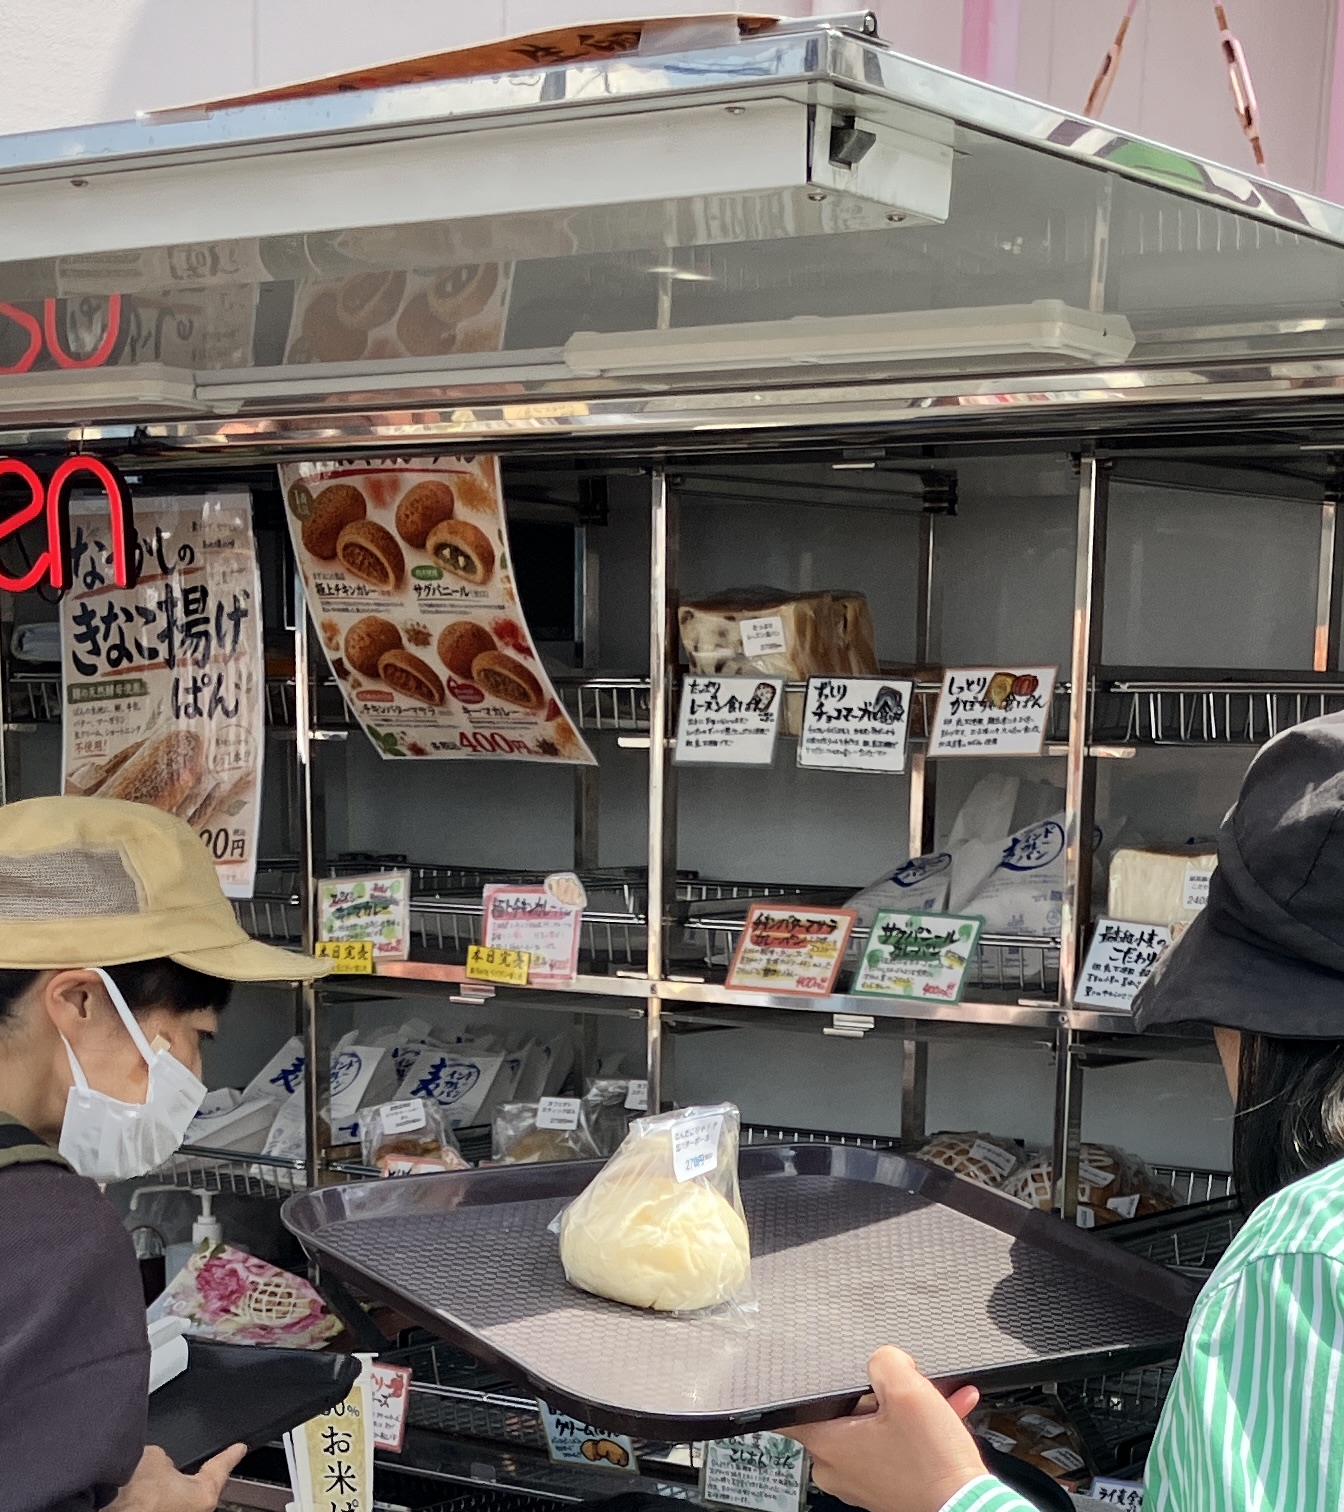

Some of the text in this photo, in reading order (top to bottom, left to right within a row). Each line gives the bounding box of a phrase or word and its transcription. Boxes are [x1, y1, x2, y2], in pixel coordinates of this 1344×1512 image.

[412, 582, 470, 598] サグパニール
[71, 584, 252, 678] きなこ揚げ
[170, 672, 241, 722] ぱん
[947, 675, 988, 697] しっとり
[881, 921, 959, 945] サグパニール
[470, 947, 525, 970] 本日完売
